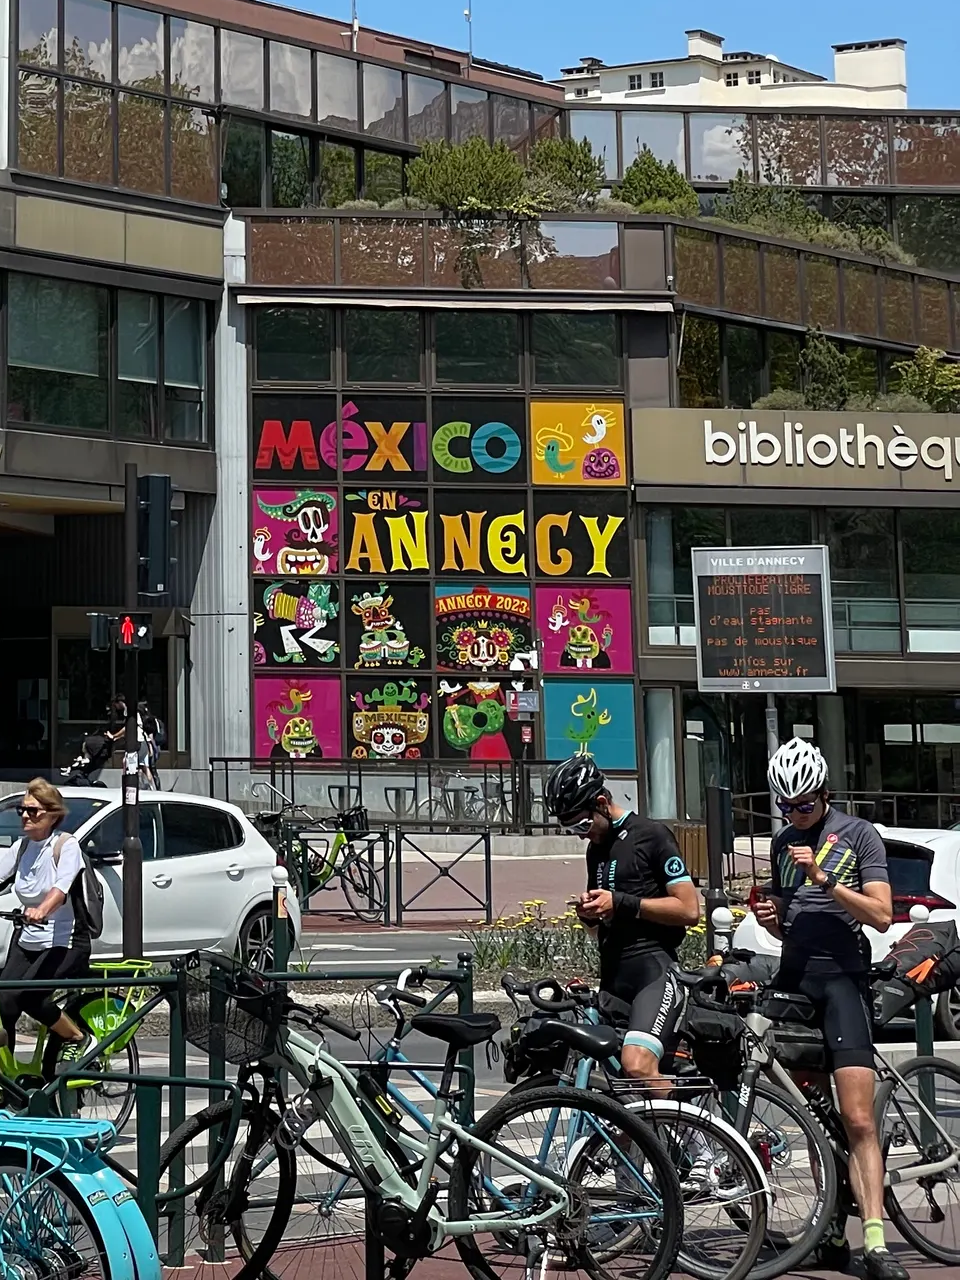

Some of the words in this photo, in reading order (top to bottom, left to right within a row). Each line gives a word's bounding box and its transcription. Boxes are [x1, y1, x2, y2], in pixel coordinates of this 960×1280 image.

[367, 489, 397, 511] EN
[344, 509, 626, 578] ANNECY
[710, 557, 743, 567] VILLE
[746, 556, 806, 566] D'ANNECY
[708, 584, 769, 596] MOUSTIQUE
[438, 594, 493, 613] ANNECY
[496, 595, 528, 614] 2023
[749, 606, 771, 616] pas
[709, 615, 744, 626] d'eau
[750, 615, 814, 626] stagnante
[706, 637, 728, 646] pas
[734, 635, 749, 646] de
[754, 635, 818, 646] moustique
[773, 656, 795, 666] sur
[365, 712, 418, 723] MEXICO
[662, 981, 674, 1016] PASSION
[739, 1082, 751, 1108] ROSE
